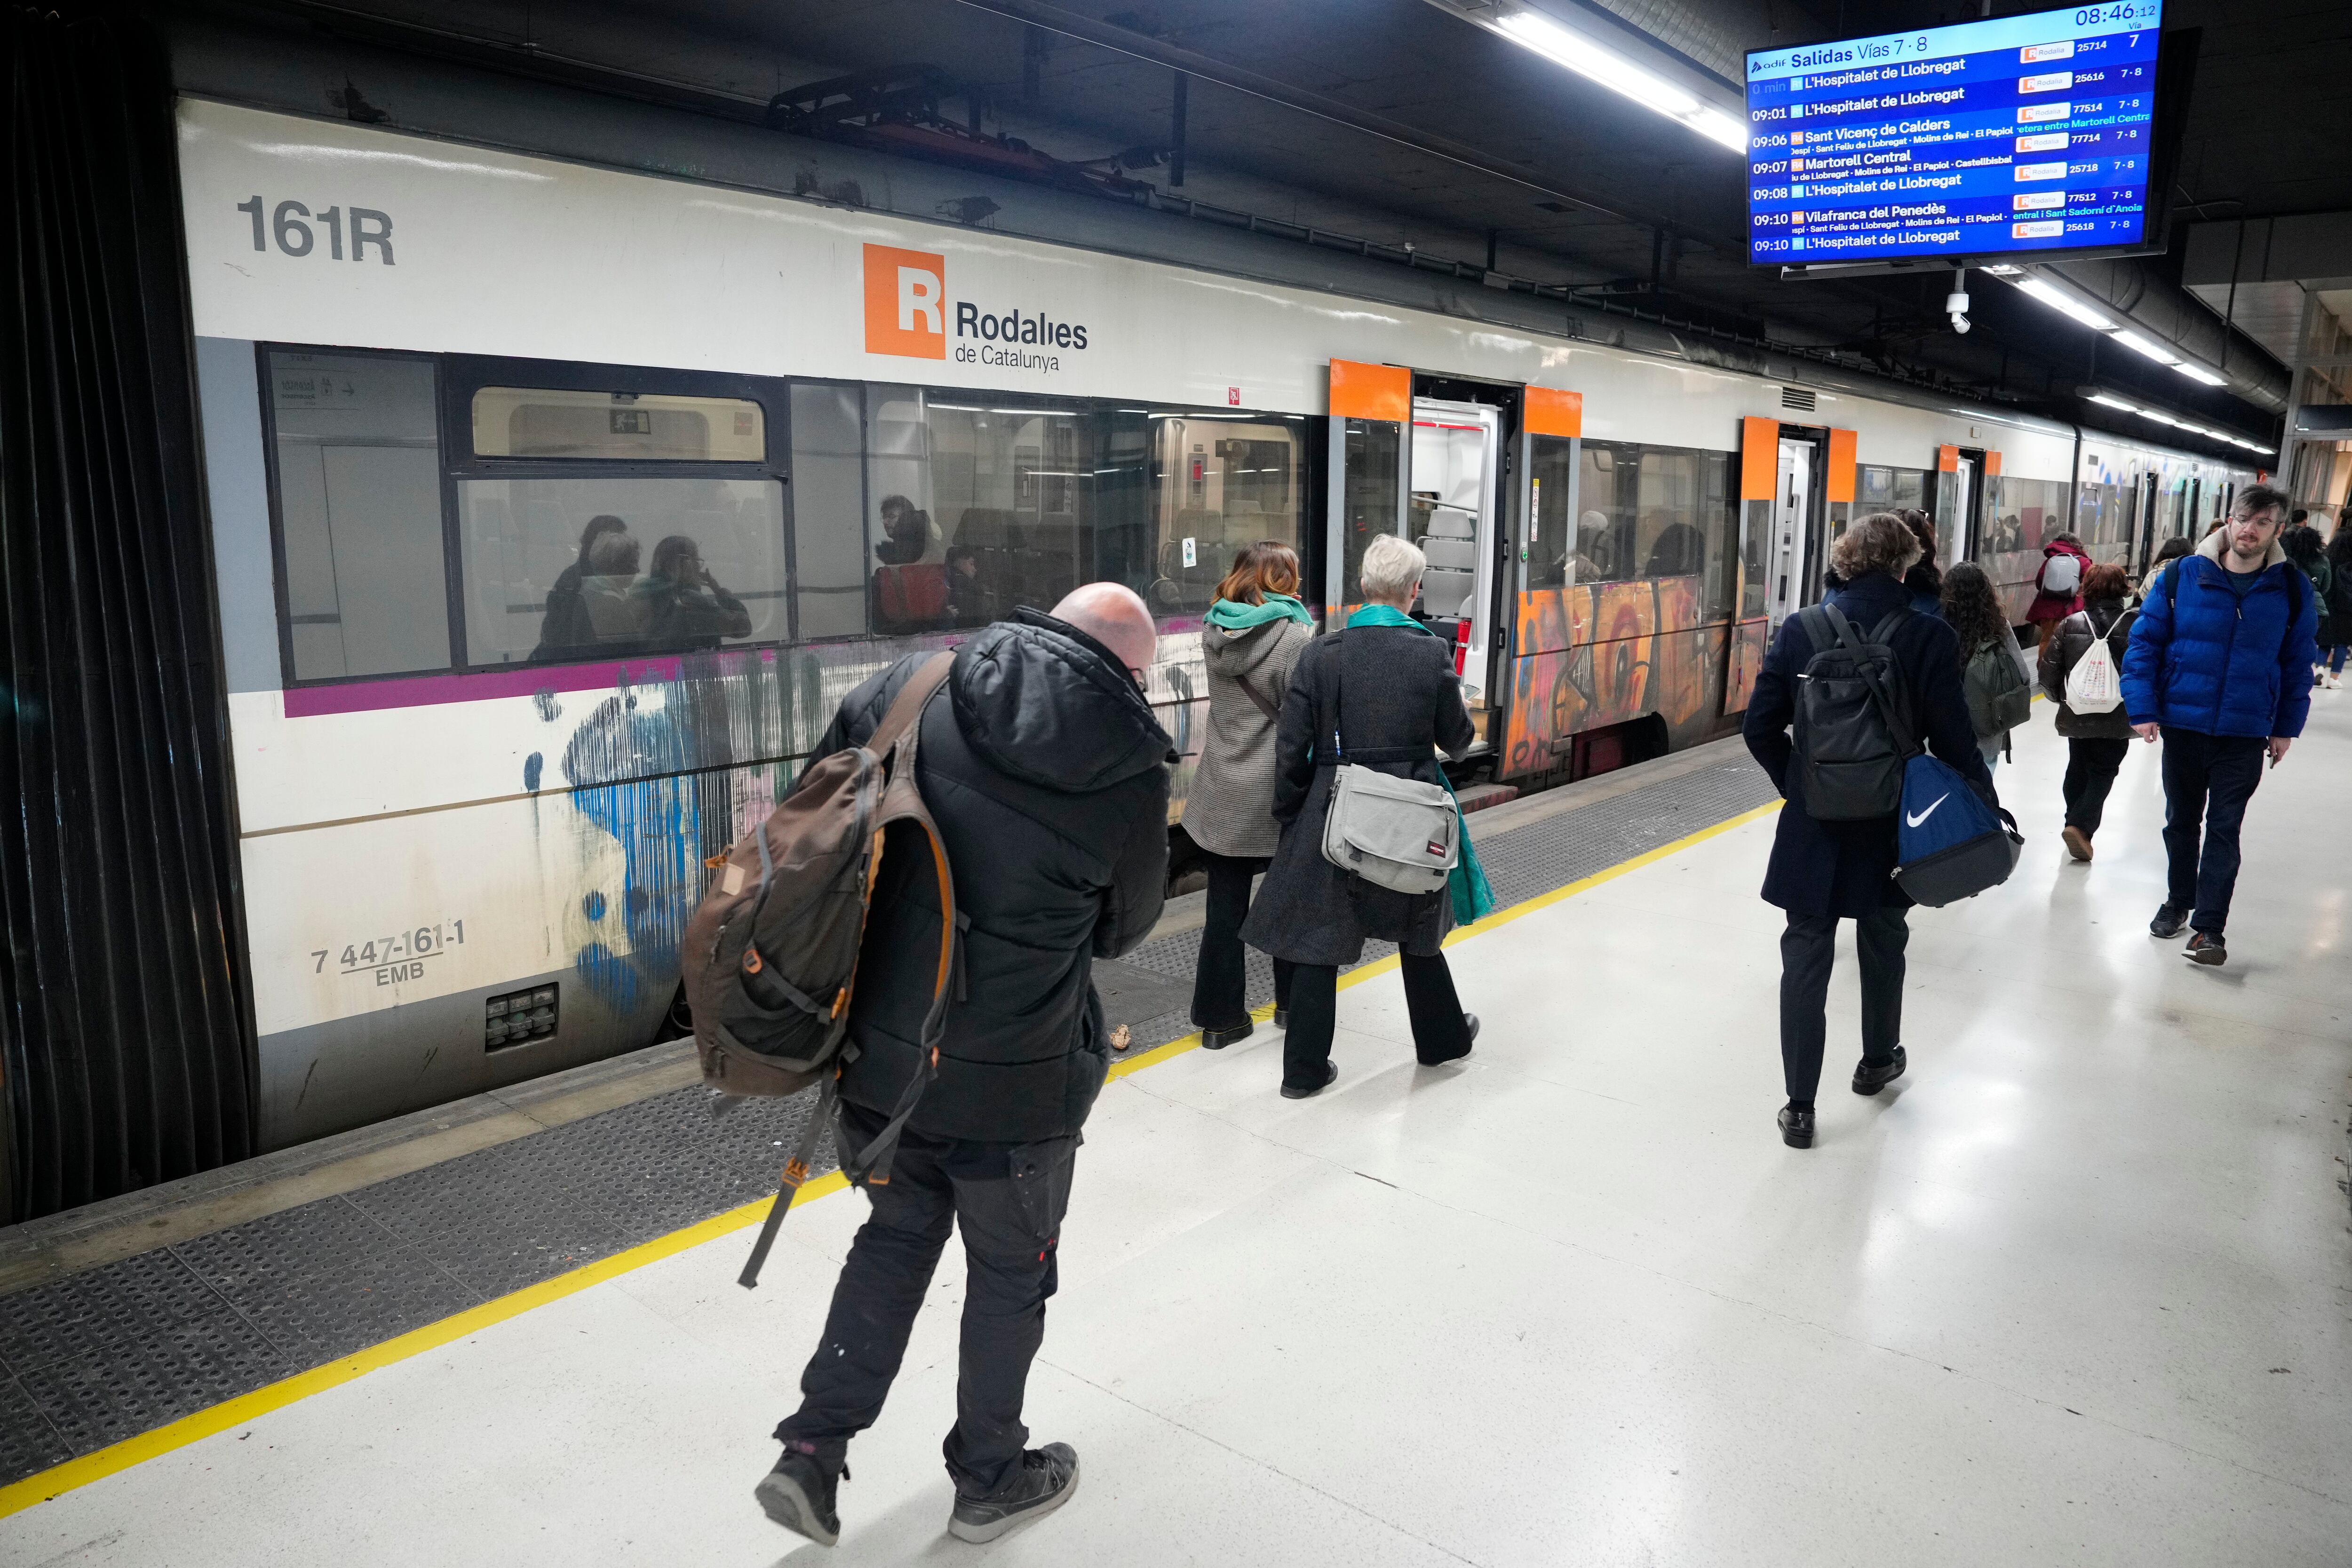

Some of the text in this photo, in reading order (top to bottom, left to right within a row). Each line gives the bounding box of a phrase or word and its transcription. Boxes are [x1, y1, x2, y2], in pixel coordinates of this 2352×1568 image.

[2077, 40, 2107, 52] 25714
[2130, 34, 2139, 47] 7
[1792, 37, 1927, 67] Salidas Vías 7 8
[2039, 47, 2065, 56] Rodalia
[1764, 59, 1786, 69] adif
[1805, 70, 1878, 88] L'Hospitalet
[1881, 67, 1898, 79] de
[1901, 58, 1965, 77] Llobregat
[2075, 72, 2105, 83] 25616
[1764, 81, 1786, 93] min
[1805, 97, 1878, 116] L'Hospitalet
[1881, 96, 1897, 107] de
[1900, 88, 1964, 105] Llobregat
[2074, 103, 2102, 113] 77514
[1752, 108, 1787, 121] 09:01
[2044, 121, 2069, 131] entre
[2072, 116, 2115, 128] Martorell
[1805, 130, 1833, 143] Sant
[1836, 127, 1877, 140] Vicenç
[1881, 123, 1897, 135] de
[1899, 119, 1950, 134] Calders
[1753, 135, 1787, 148] 09:06
[1836, 142, 1854, 151] Feliu
[1868, 137, 1907, 148] Llobregat
[1913, 135, 1941, 143] Molins
[1943, 132, 1954, 141] de
[1955, 131, 1969, 139] Rei
[1976, 129, 1984, 137] El
[1986, 127, 2013, 137] Papiol
[2072, 134, 2100, 143] 77714
[1805, 154, 1861, 169] Martorell
[1864, 150, 1911, 164] Central
[1753, 161, 1787, 174] 09:07
[1800, 172, 1810, 181] de
[1811, 170, 1849, 180] Llobregat
[1895, 164, 1907, 173] Rei
[1914, 163, 1921, 171] El
[1923, 161, 1949, 171] Papiol
[1955, 155, 2012, 167] Castellbisbal
[2070, 164, 2098, 174] 25718
[1806, 181, 1877, 197] L'Hospitalet
[1880, 179, 1896, 191] de
[1899, 174, 1962, 189] Llobregat
[1754, 187, 1788, 200] 09:08
[2068, 193, 2096, 202] 77512
[1805, 210, 1866, 223] Vilafranca
[1869, 206, 1889, 218] del
[1892, 203, 1946, 217] Penedès
[2046, 208, 2066, 217] Sant
[2068, 204, 2104, 216] Sadorní
[1754, 214, 1788, 226] 09:10
[1829, 223, 1848, 231] Feliu
[1861, 220, 1899, 230] Llobregat
[1906, 218, 1932, 227] Molins
[1934, 216, 1945, 225] de
[1966, 215, 1974, 223] El
[1976, 214, 2002, 223] Papiol
[2066, 223, 2094, 231] 25618
[238, 195, 396, 266] 161R
[1755, 239, 1788, 251] 09:10
[1806, 235, 1877, 249] L'Hospitalet
[1880, 233, 1895, 245] de
[1899, 230, 1960, 244] Llobregat
[898, 265, 943, 334] R
[957, 302, 1088, 350] Rodalies
[956, 344, 1059, 374] de Catalunya
[311, 920, 464, 973] 7 447-161-1
[377, 962, 424, 987] EMB
